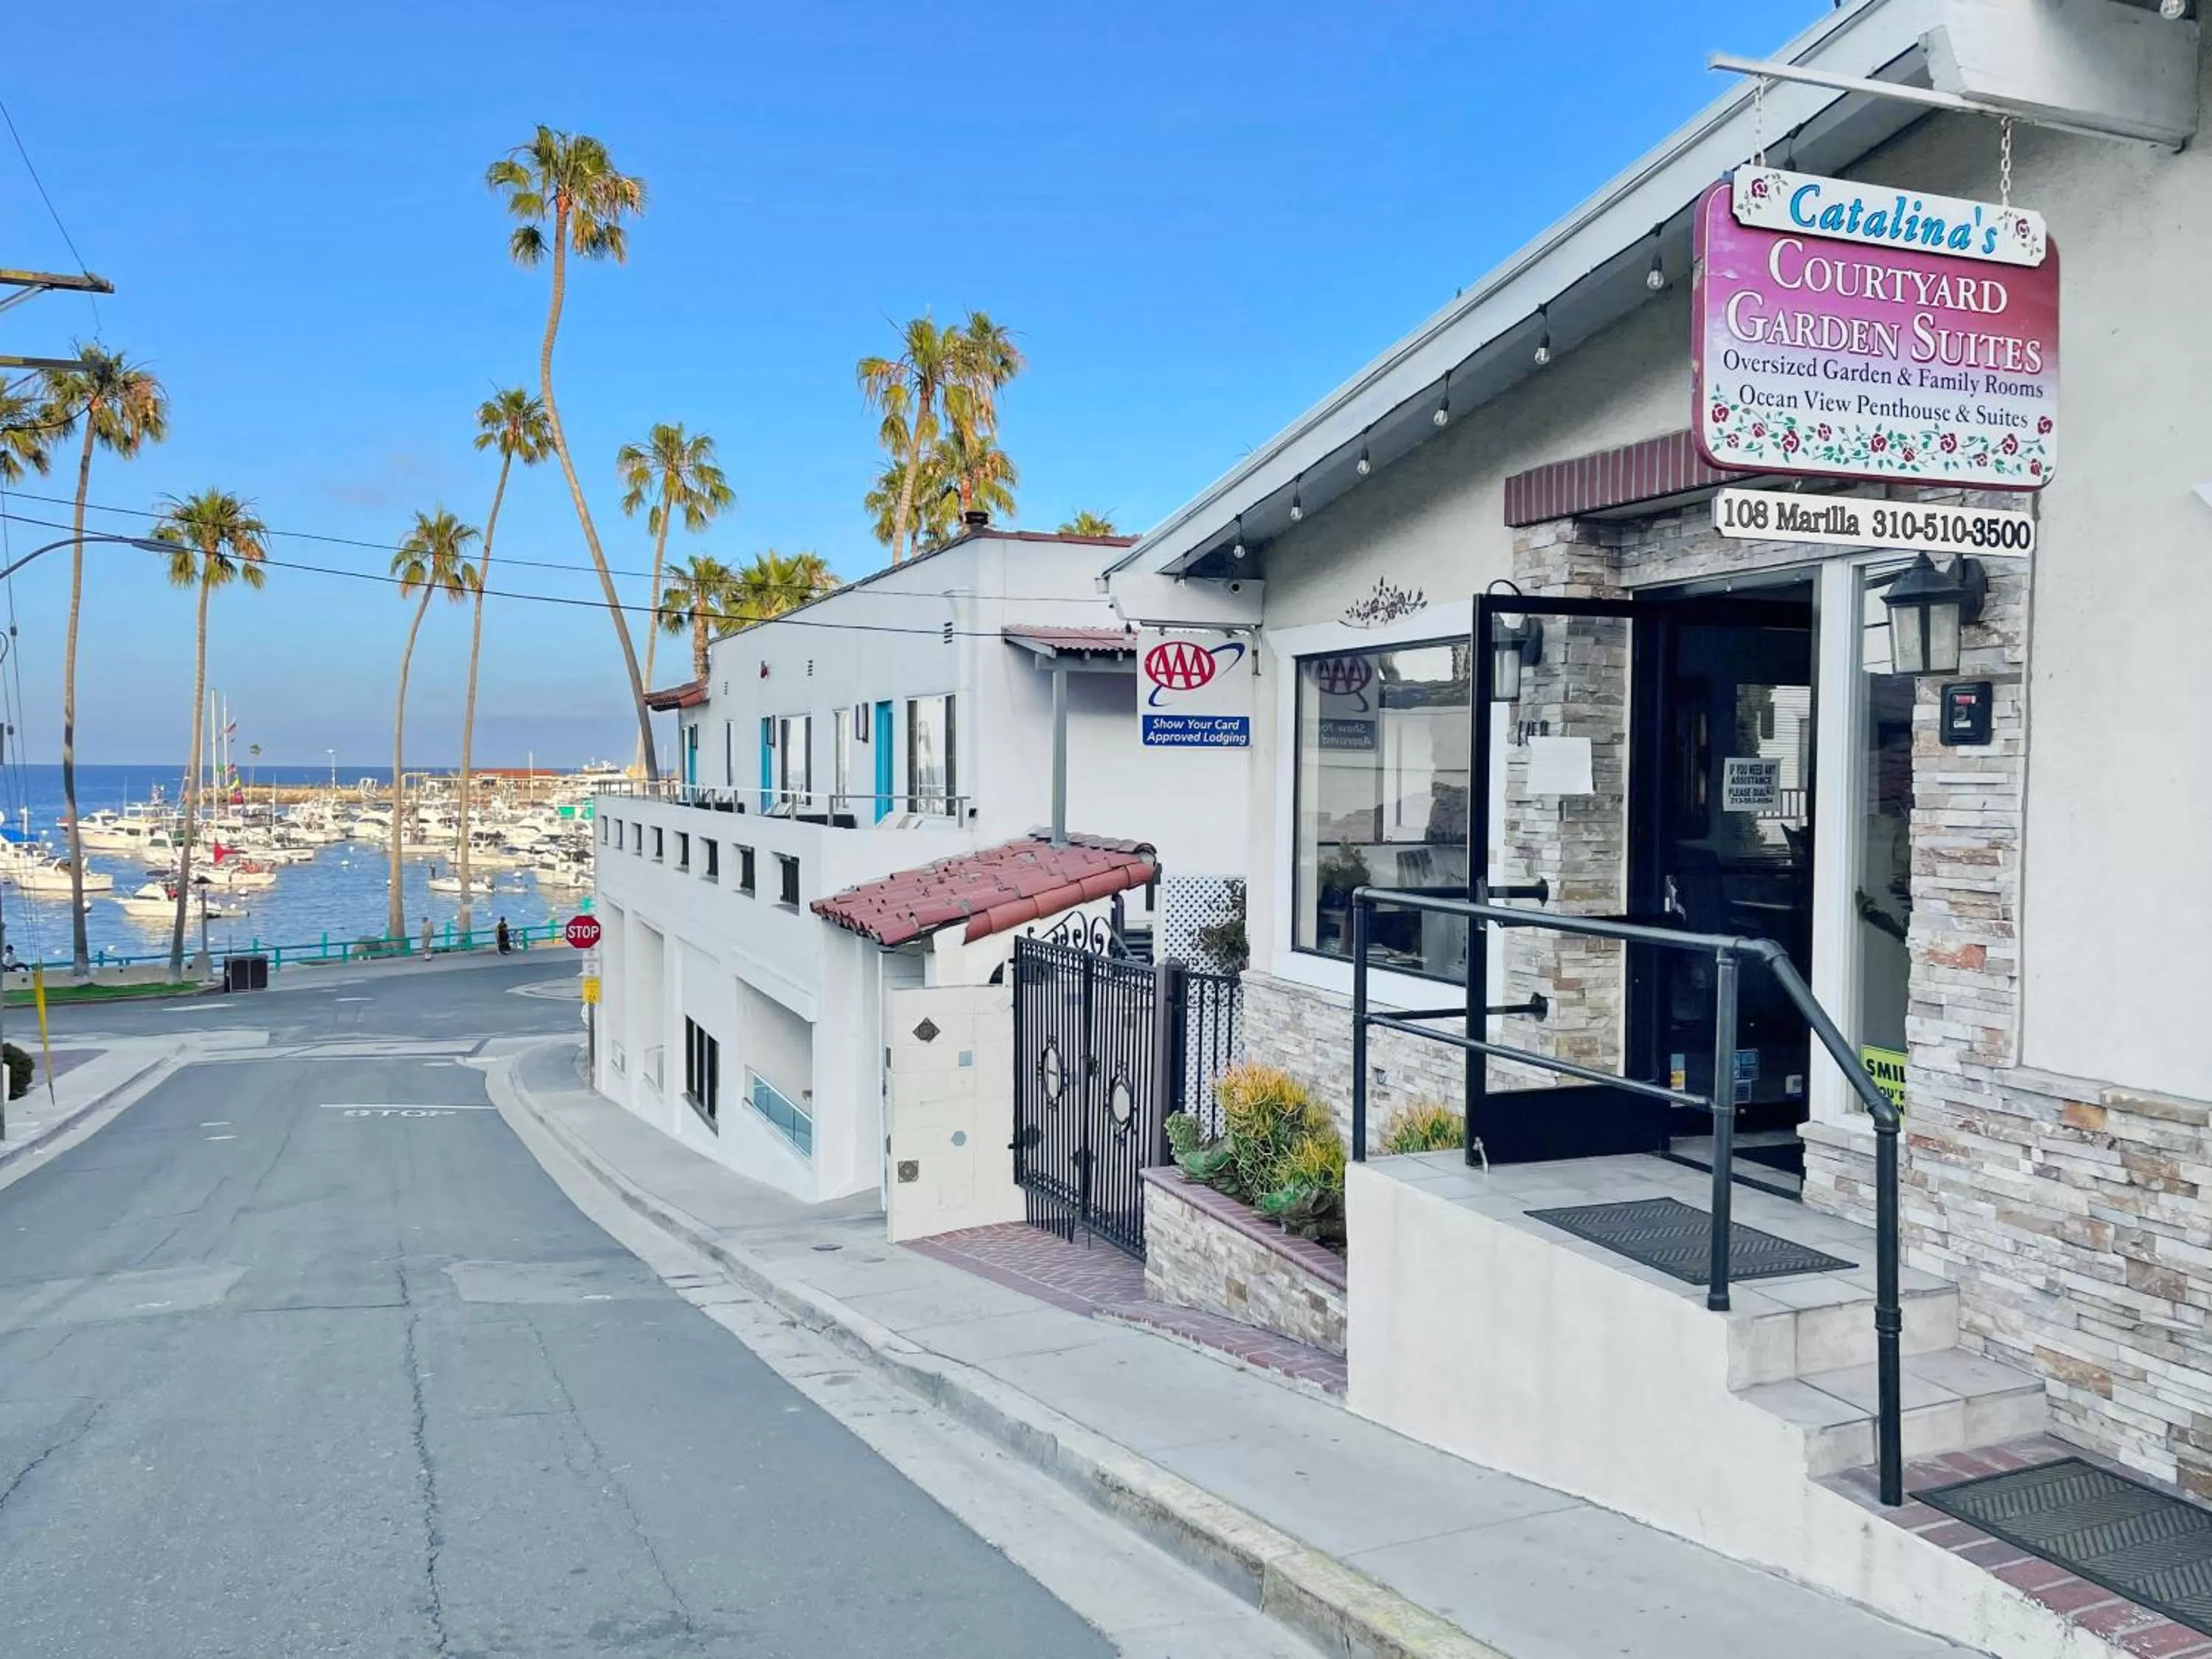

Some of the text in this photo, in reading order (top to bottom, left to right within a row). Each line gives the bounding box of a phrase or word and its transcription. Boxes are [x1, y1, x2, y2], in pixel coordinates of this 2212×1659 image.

[1790, 184, 1998, 254] Catalina's
[1769, 238, 2008, 315] COURTYARD
[1725, 290, 2043, 374] GARDEN SUITES
[1723, 349, 2044, 399] Oversized Garden & Family Rooms
[1739, 383, 2029, 428] Ocean View Penthouse & Suites
[1723, 498, 2031, 550] 108 Marilla 310-510-3500
[1150, 641, 1211, 690] AAA
[1147, 731, 1247, 746] Approved Lodging
[1152, 718, 1240, 731] Show Your Card
[567, 925, 599, 939] STOP
[1866, 1059, 1906, 1082] SMIL
